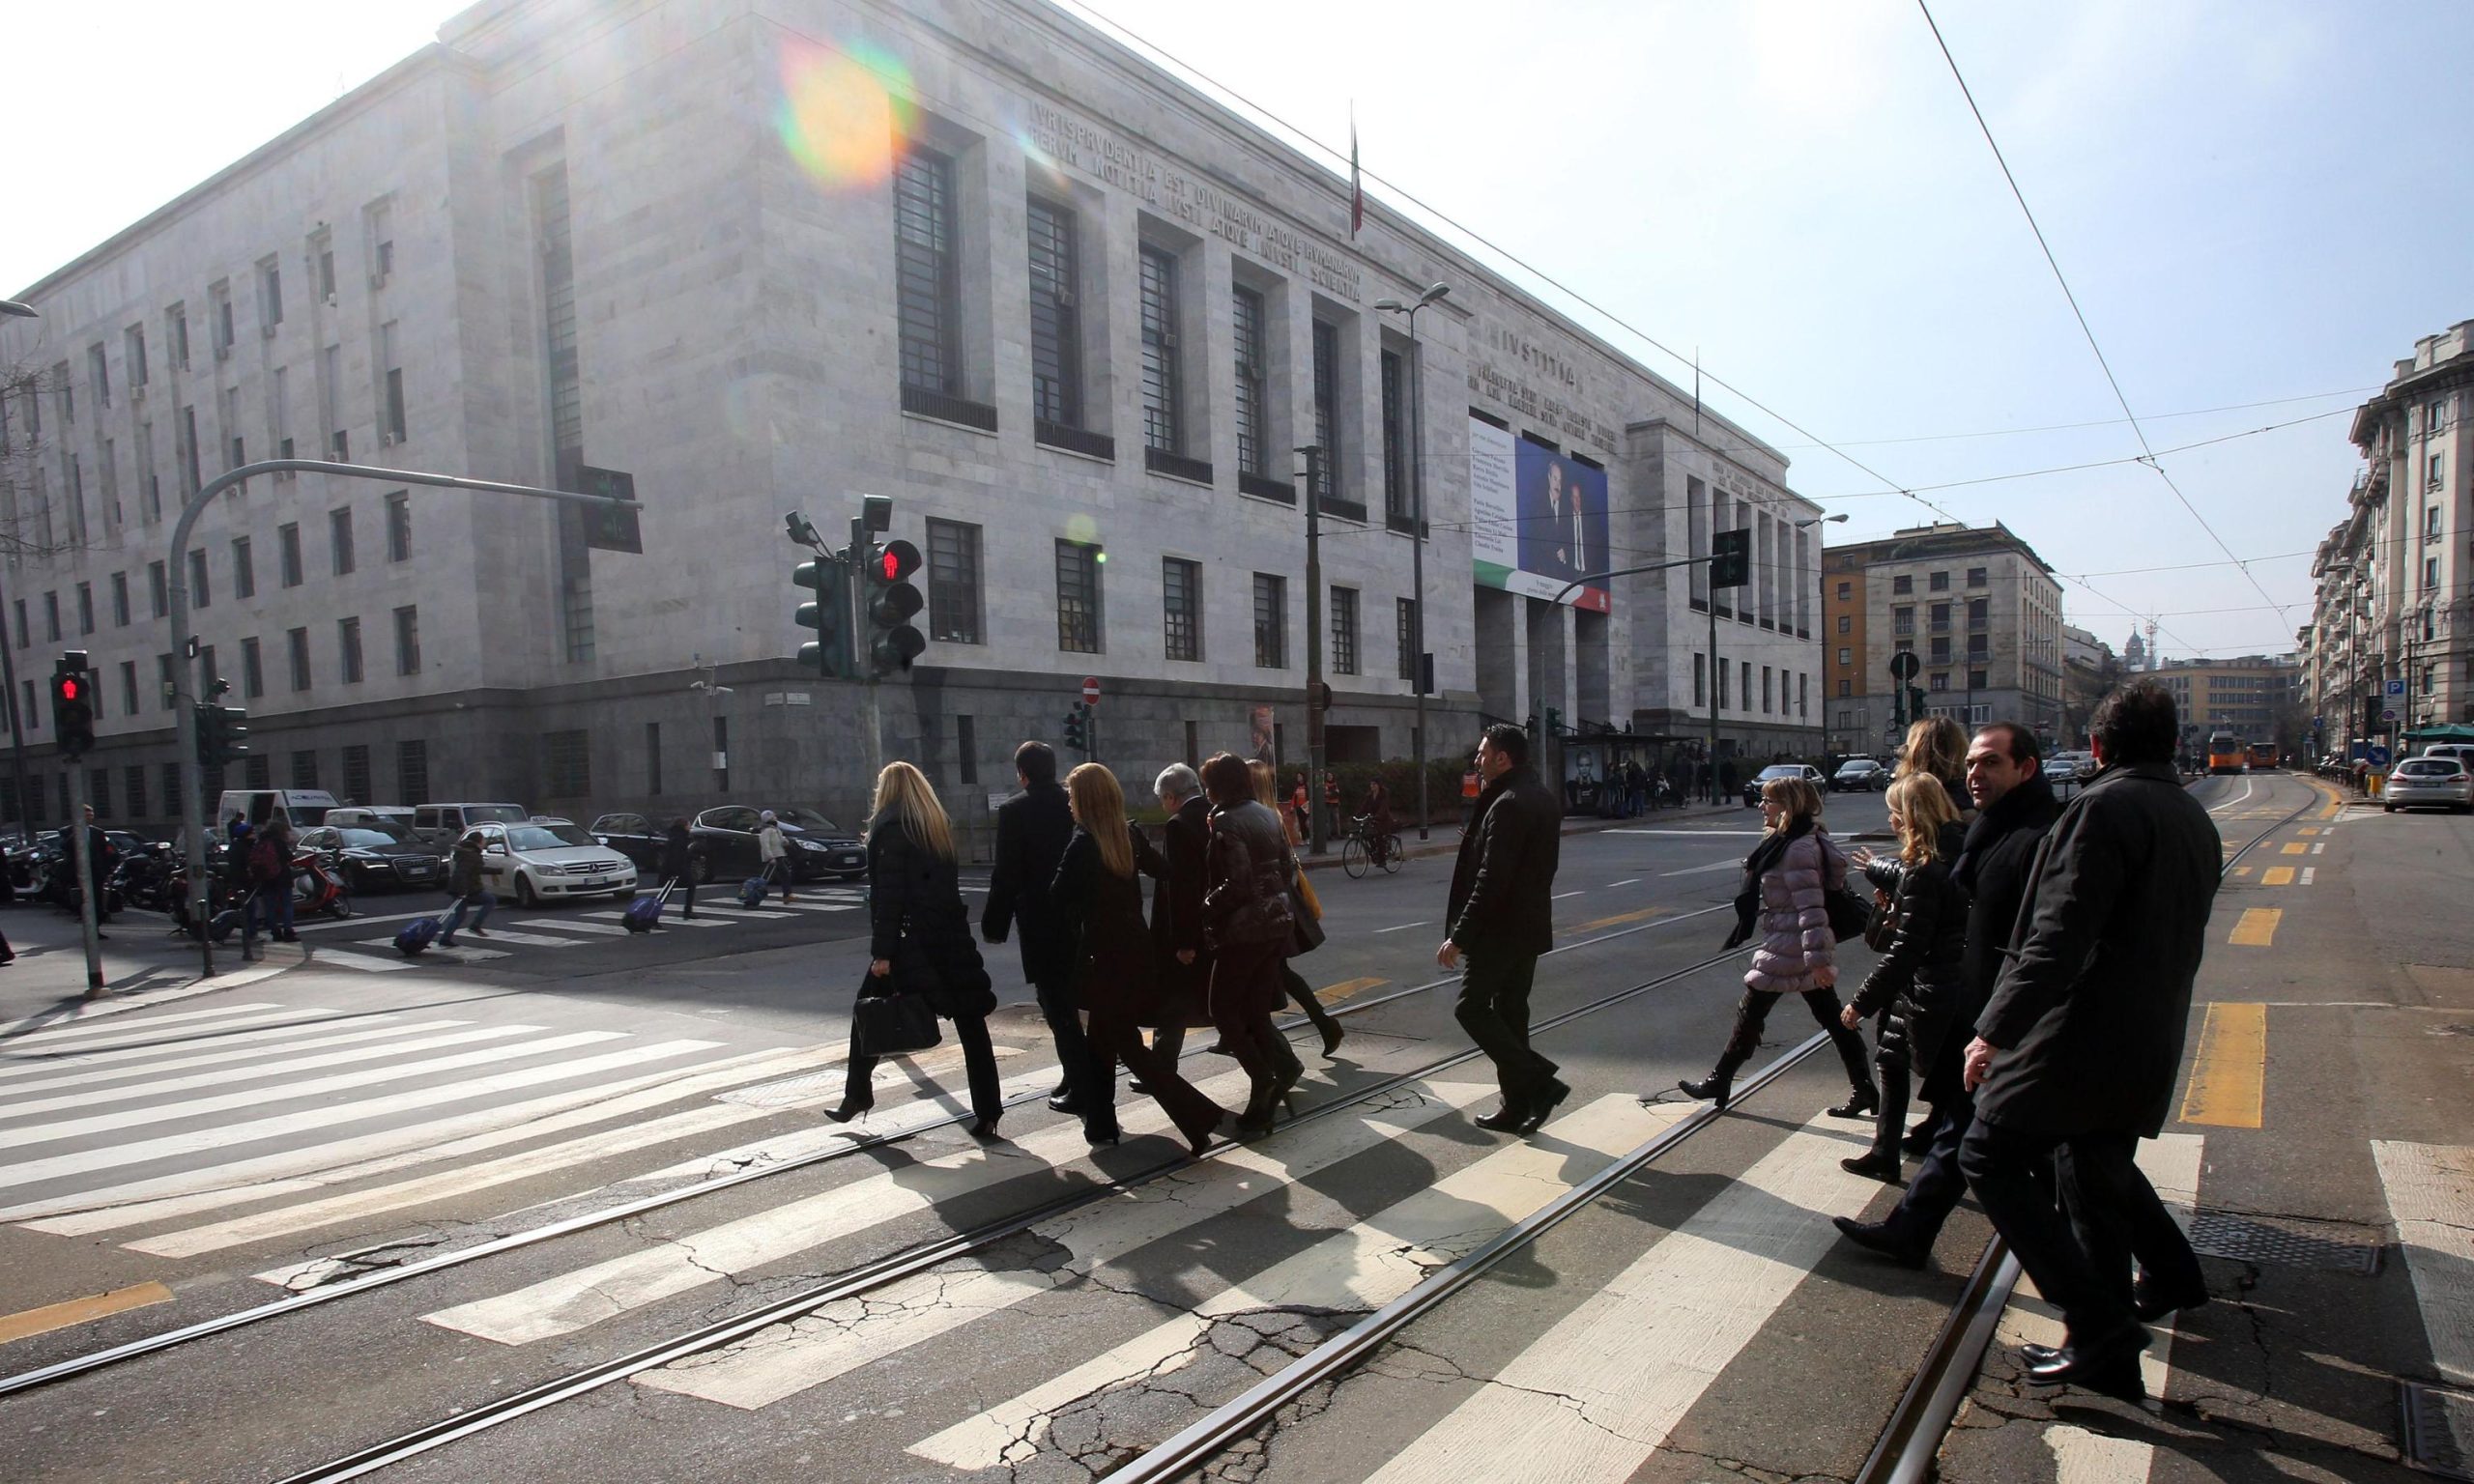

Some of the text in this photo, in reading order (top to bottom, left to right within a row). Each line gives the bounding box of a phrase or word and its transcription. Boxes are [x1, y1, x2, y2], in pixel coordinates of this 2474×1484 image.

[1165, 169, 1186, 197] EST
[1195, 186, 1260, 235] DIVINARVM
[2391, 683, 2401, 693] P
